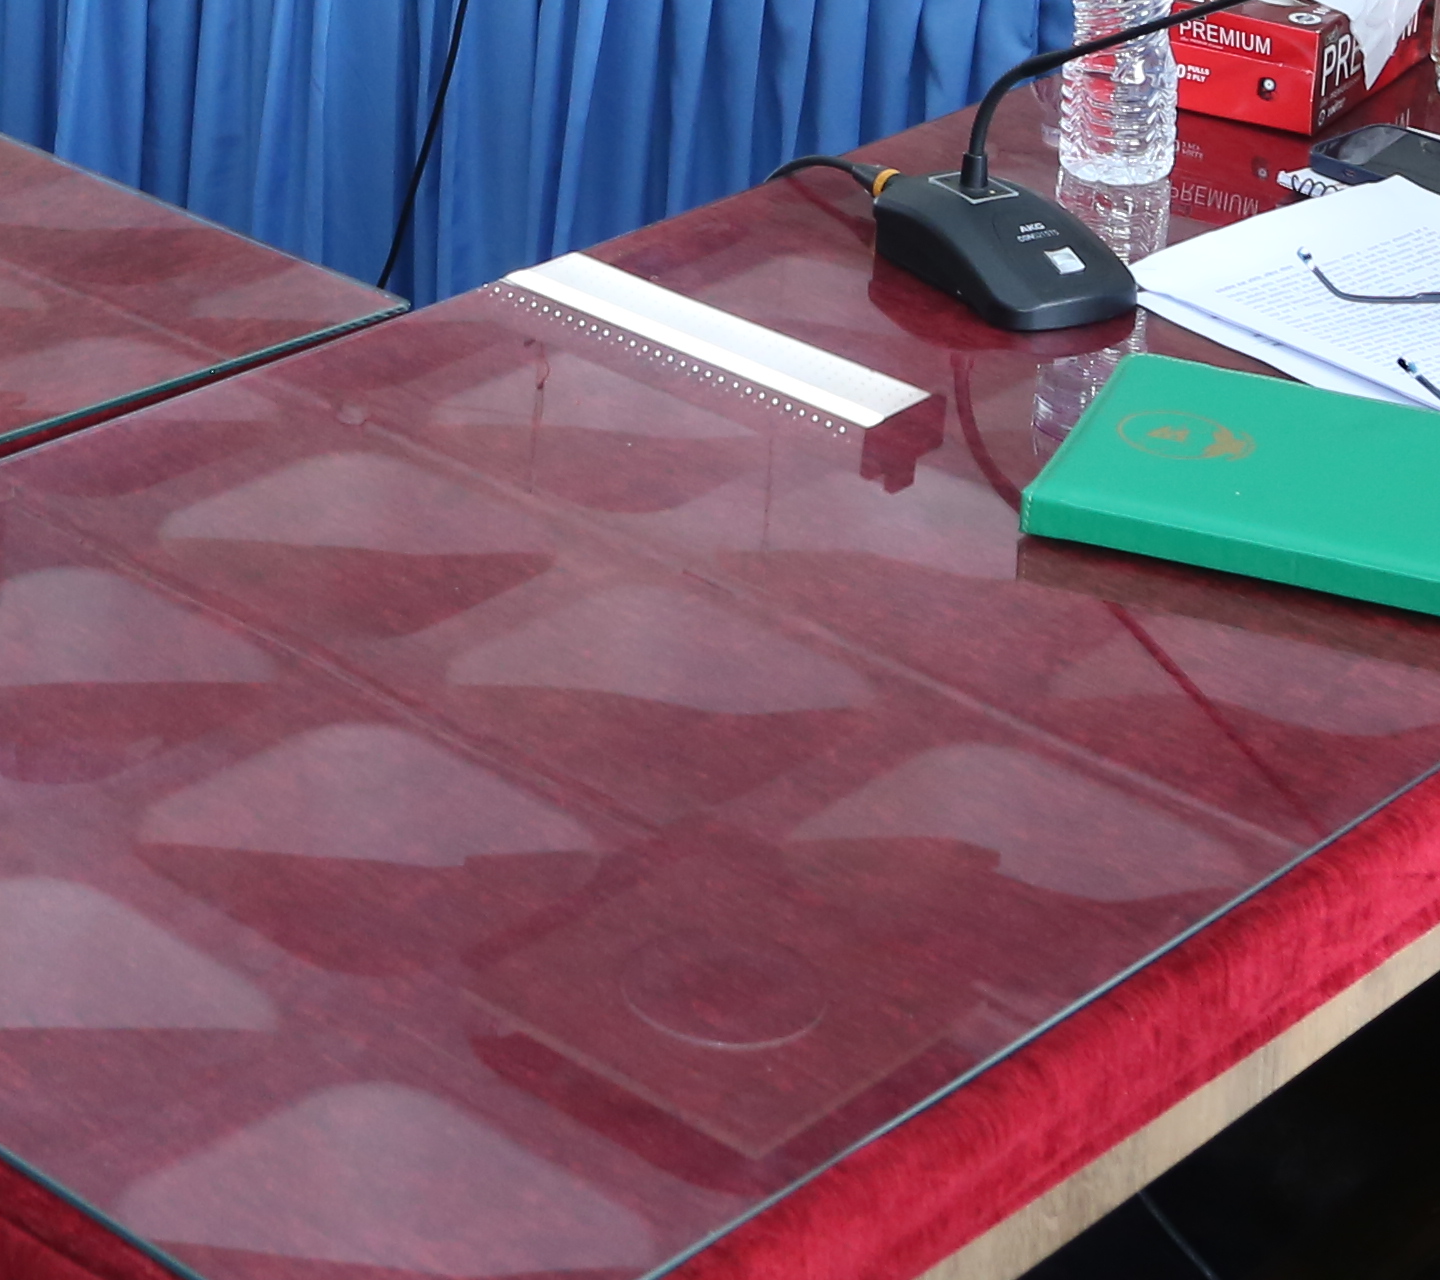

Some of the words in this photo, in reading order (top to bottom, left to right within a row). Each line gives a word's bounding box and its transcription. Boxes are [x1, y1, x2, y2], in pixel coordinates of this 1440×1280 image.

[1178, 19, 1271, 57] PREMIUM
[1187, 64, 1210, 76] PULLS
[1019, 222, 1046, 234] AKG
